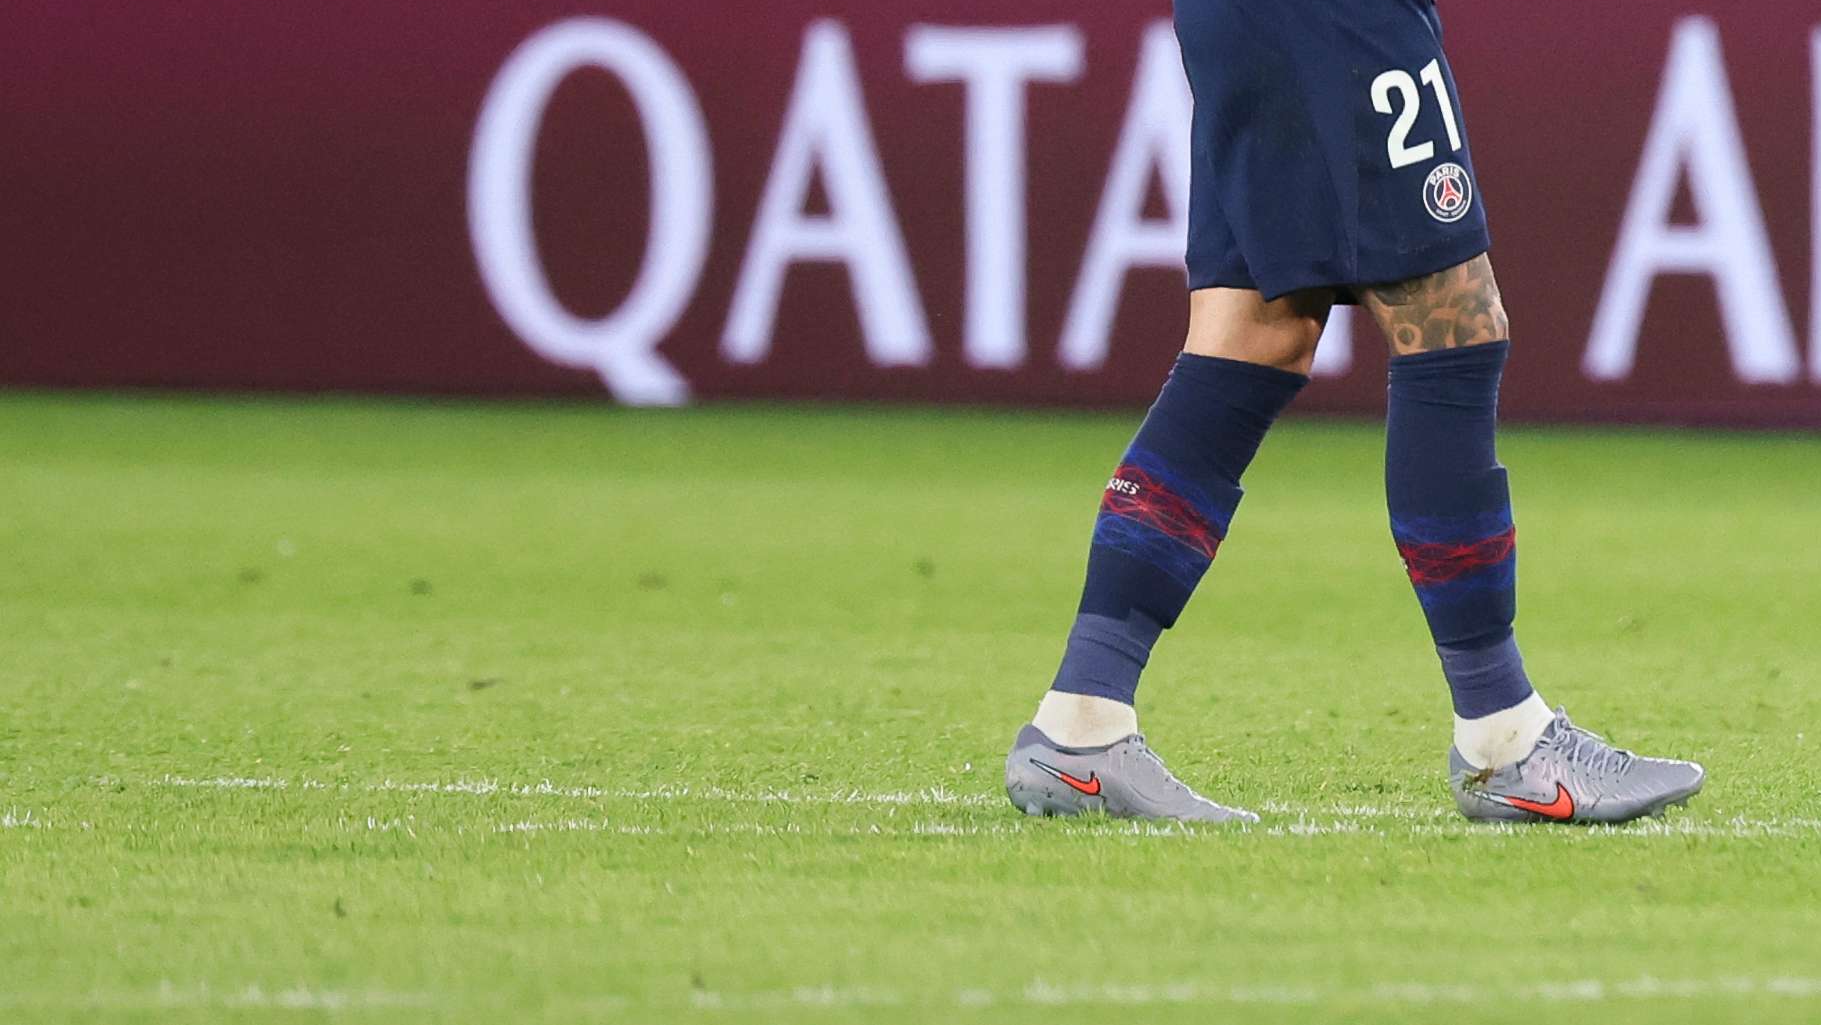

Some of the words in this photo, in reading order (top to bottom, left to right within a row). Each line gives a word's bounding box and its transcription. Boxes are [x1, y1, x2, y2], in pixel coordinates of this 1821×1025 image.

[1370, 58, 1462, 169] 21
[466, 15, 1353, 407] QATA
[1429, 166, 1461, 186] PARIS
